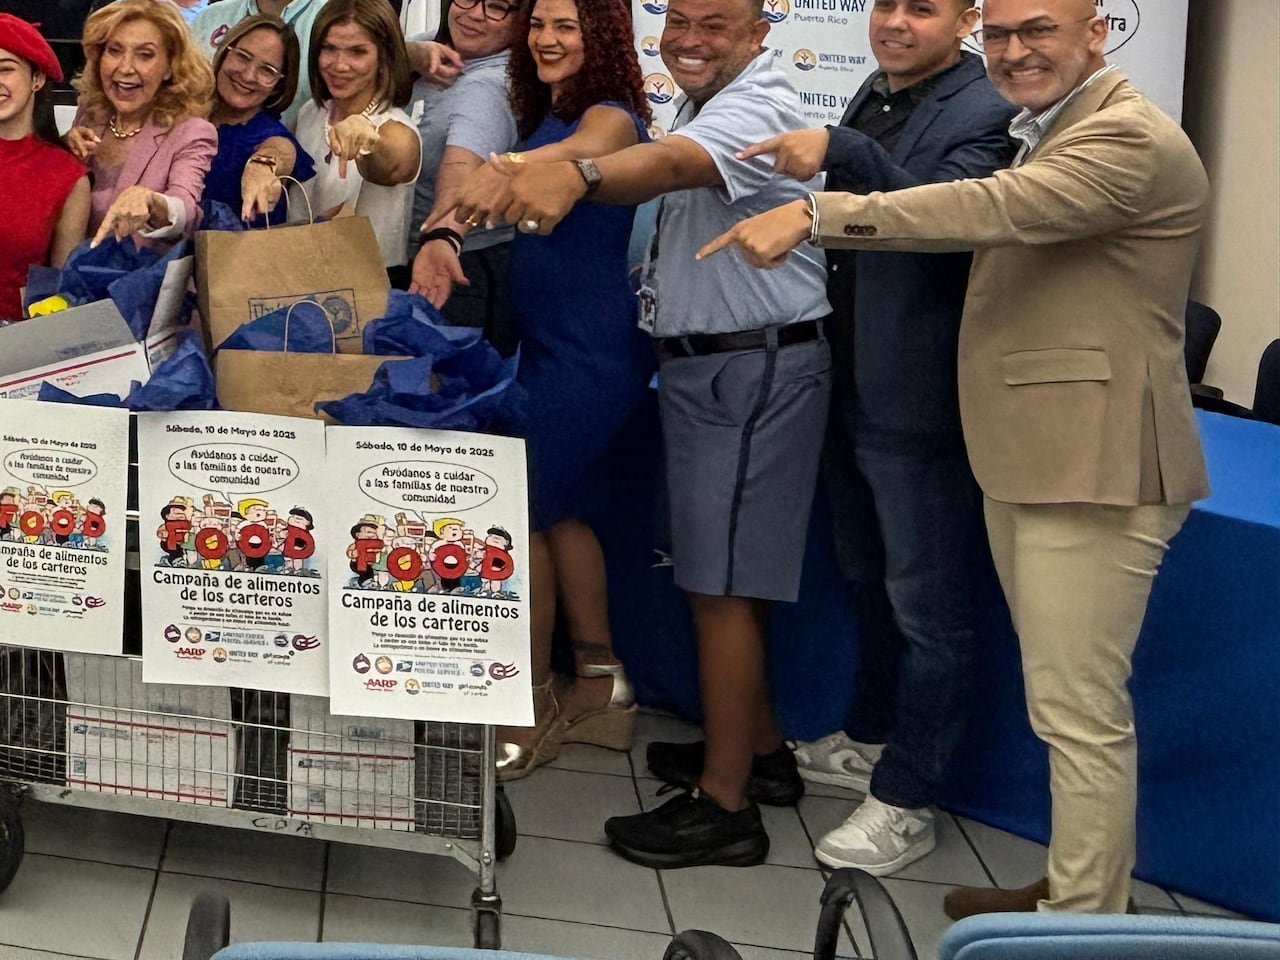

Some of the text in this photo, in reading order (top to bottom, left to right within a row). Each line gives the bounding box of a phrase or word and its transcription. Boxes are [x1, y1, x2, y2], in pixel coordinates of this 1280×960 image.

[795, 14, 848, 24] Puerto Rico
[166, 425, 203, 434] Sábado,
[231, 427, 256, 437] Mayo
[260, 429, 270, 437] de
[273, 430, 296, 439] 2025
[191, 450, 237, 460] Ayúdanos
[249, 453, 278, 463] cuidar
[356, 441, 494, 457] Sábado, 10 de Mayo de 2025
[184, 461, 197, 470] las
[201, 462, 237, 472] familias
[241, 464, 252, 473] de
[256, 466, 290, 476] nuestra
[382, 467, 431, 478] Ayúdanos
[444, 471, 475, 481] cuidar
[210, 475, 260, 485] comunidad
[375, 478, 389, 488] las
[392, 480, 431, 490] familias
[435, 482, 446, 491] de
[451, 484, 488, 494] nuestra
[402, 493, 455, 504] comunidad
[0, 504, 106, 537] FOOD
[165, 519, 315, 560] FOOD
[40, 548, 51, 560] de
[55, 551, 108, 566] alimentos
[355, 538, 514, 582] FOOD
[7, 557, 87, 575] de los carteros
[153, 570, 320, 595] Campaña de alimentos
[180, 587, 293, 608] de los carteros
[342, 593, 519, 619] Campaña de alimentos
[370, 612, 490, 633] de los carteros
